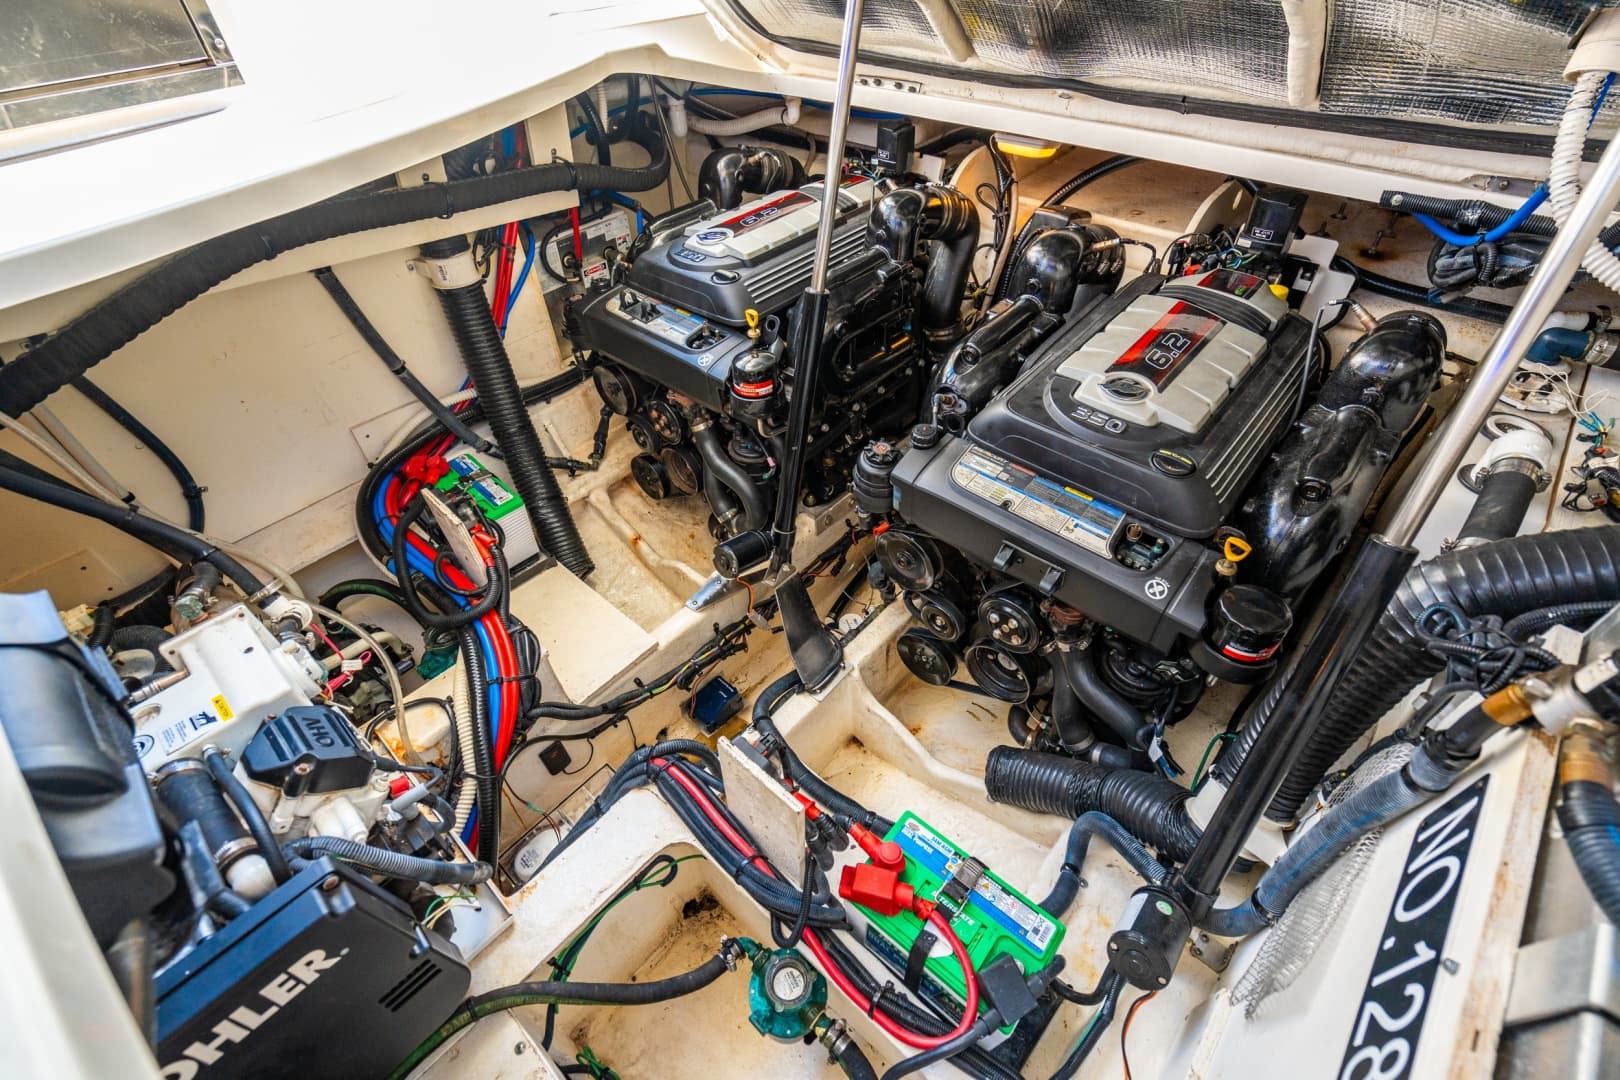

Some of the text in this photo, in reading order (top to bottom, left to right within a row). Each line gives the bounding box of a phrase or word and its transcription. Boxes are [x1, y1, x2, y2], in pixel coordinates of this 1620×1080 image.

[740, 206, 778, 227] 6.2
[1145, 332, 1192, 370] 6.2
[1071, 406, 1127, 434] 350
[302, 716, 335, 748] OHV
